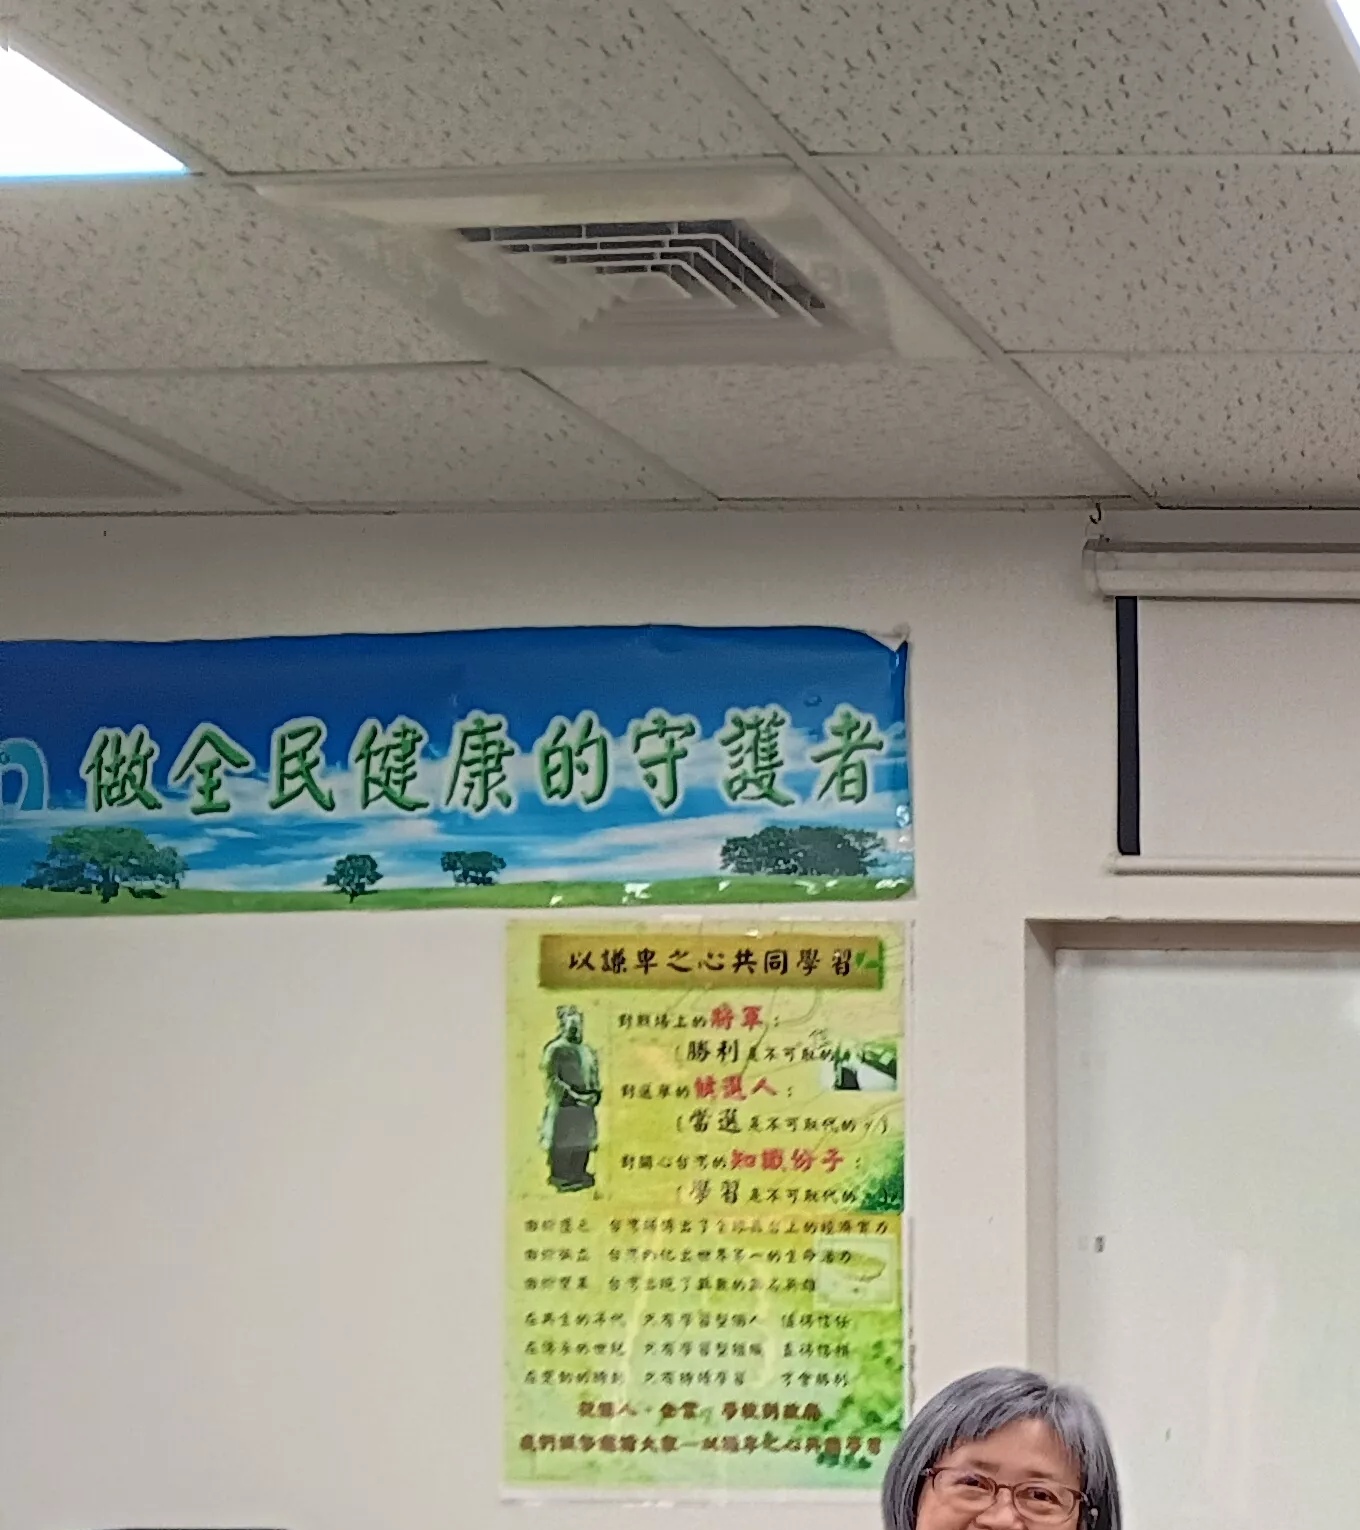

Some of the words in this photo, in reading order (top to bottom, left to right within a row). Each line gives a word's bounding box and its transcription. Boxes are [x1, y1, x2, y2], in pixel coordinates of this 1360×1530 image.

[83, 708, 887, 815] 做全民健康的守護者
[568, 948, 855, 976] 以謙卑之心共同學習
